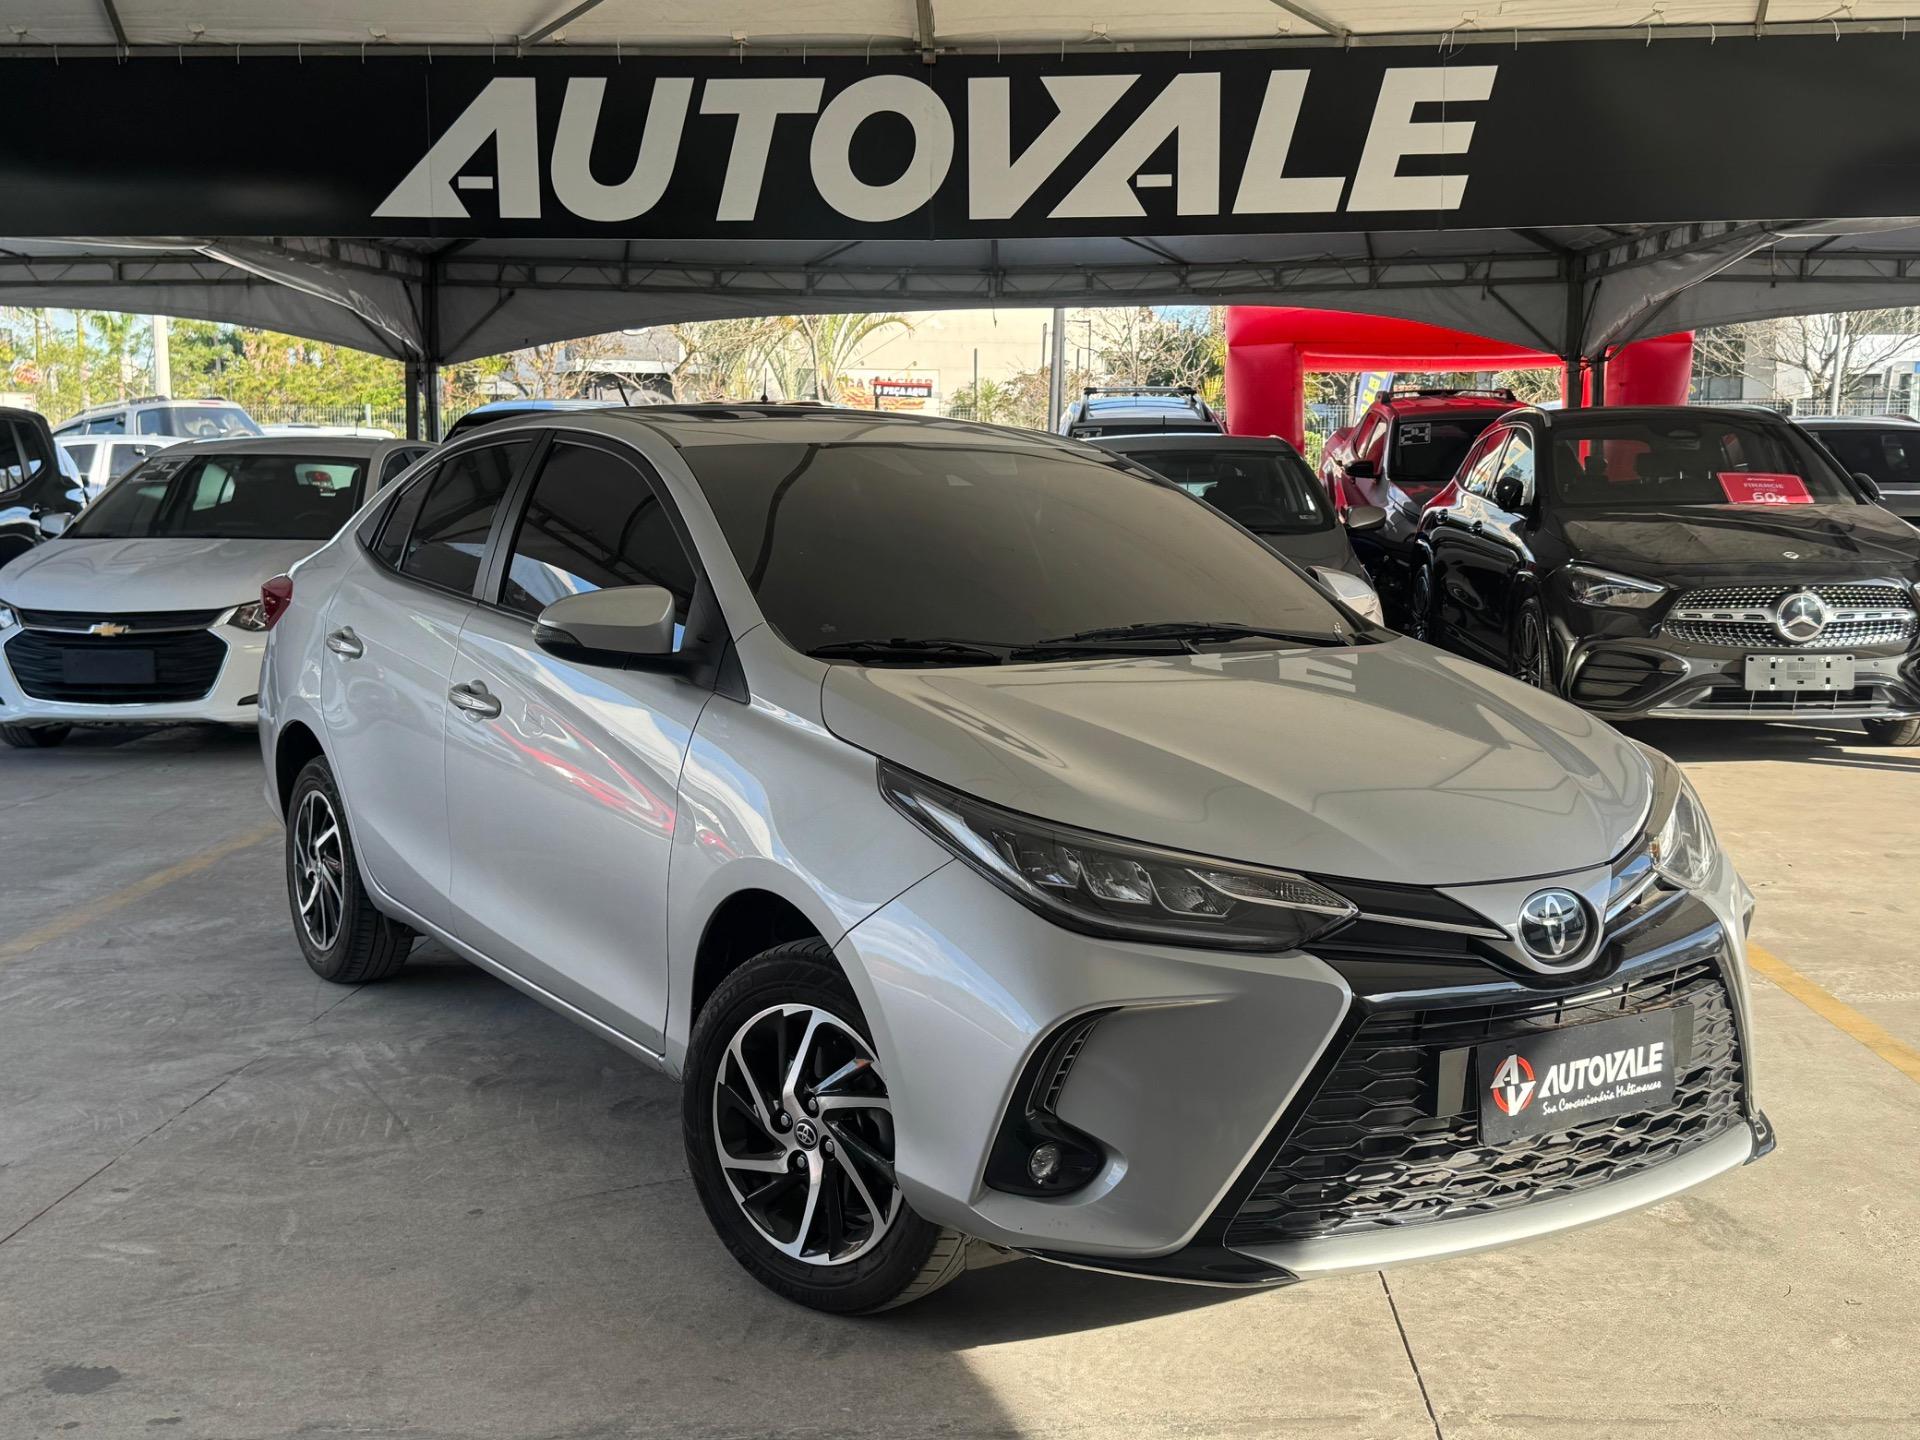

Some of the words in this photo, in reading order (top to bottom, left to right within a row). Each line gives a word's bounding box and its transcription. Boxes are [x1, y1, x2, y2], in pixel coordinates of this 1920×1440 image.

[371, 65, 1498, 223] AUTOVALE
[1753, 492, 1788, 502] 60x
[1538, 1042, 1664, 1099] AUTOVALE
[1543, 1101, 1558, 1116] Sua
[1620, 1080, 1662, 1099] Multimarcas
